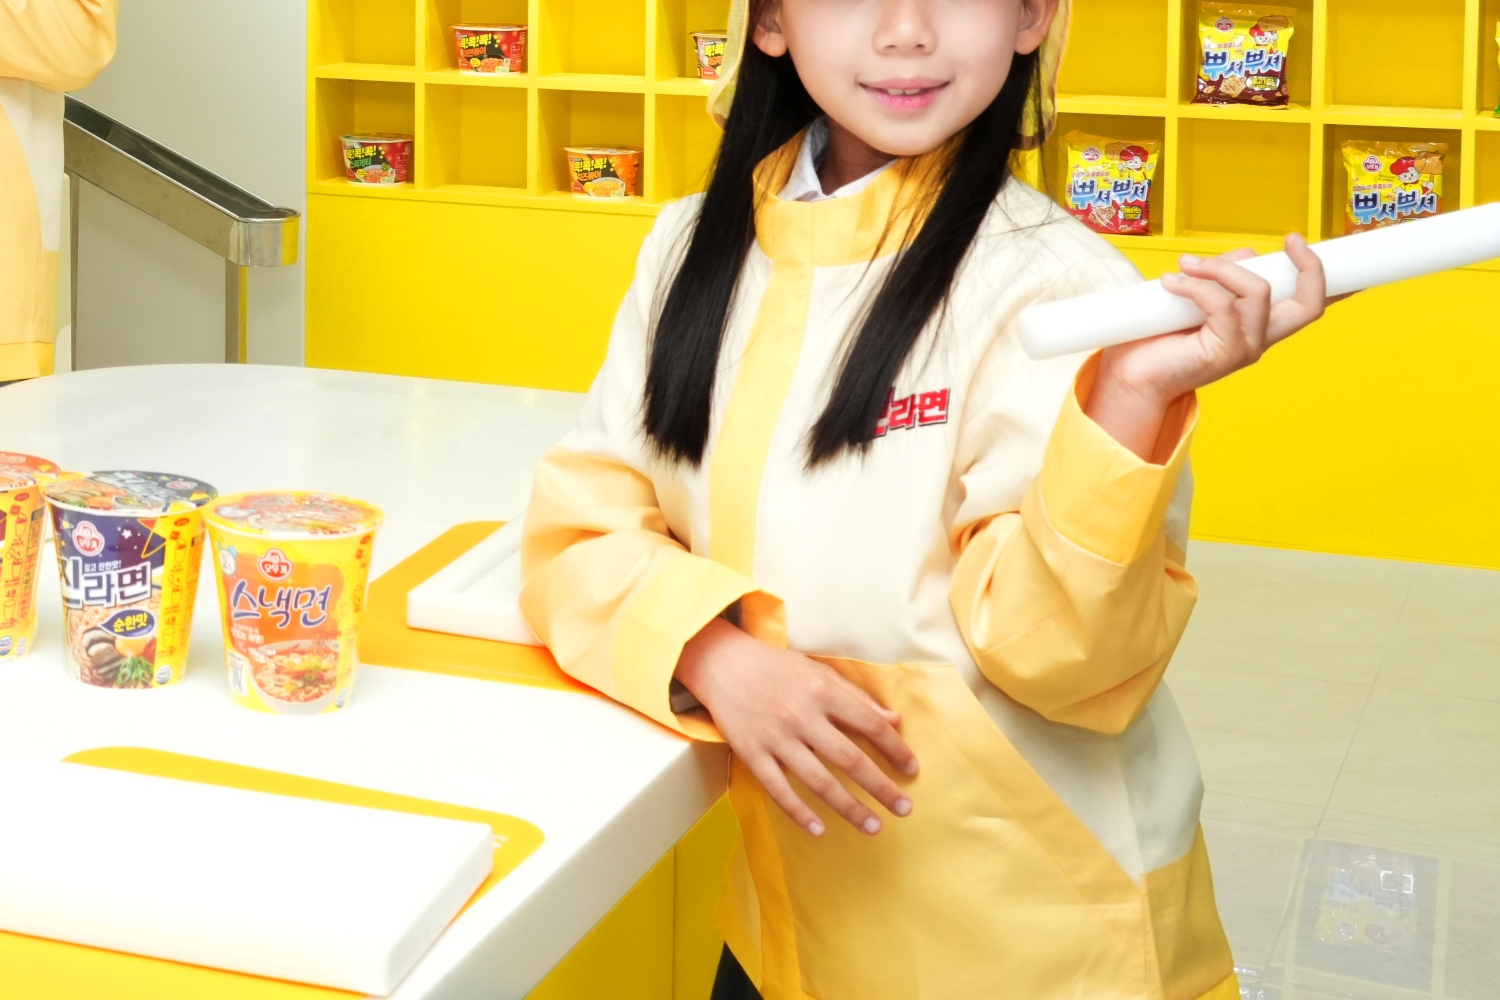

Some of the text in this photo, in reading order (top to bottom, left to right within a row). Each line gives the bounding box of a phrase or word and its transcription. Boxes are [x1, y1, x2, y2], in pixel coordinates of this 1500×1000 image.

[1203, 49, 1283, 80] 뿌셔뿌셔
[1353, 190, 1437, 225] 뿌셔뿌셔
[230, 579, 333, 629] 스낵면
[113, 613, 149, 632] 순한맛
